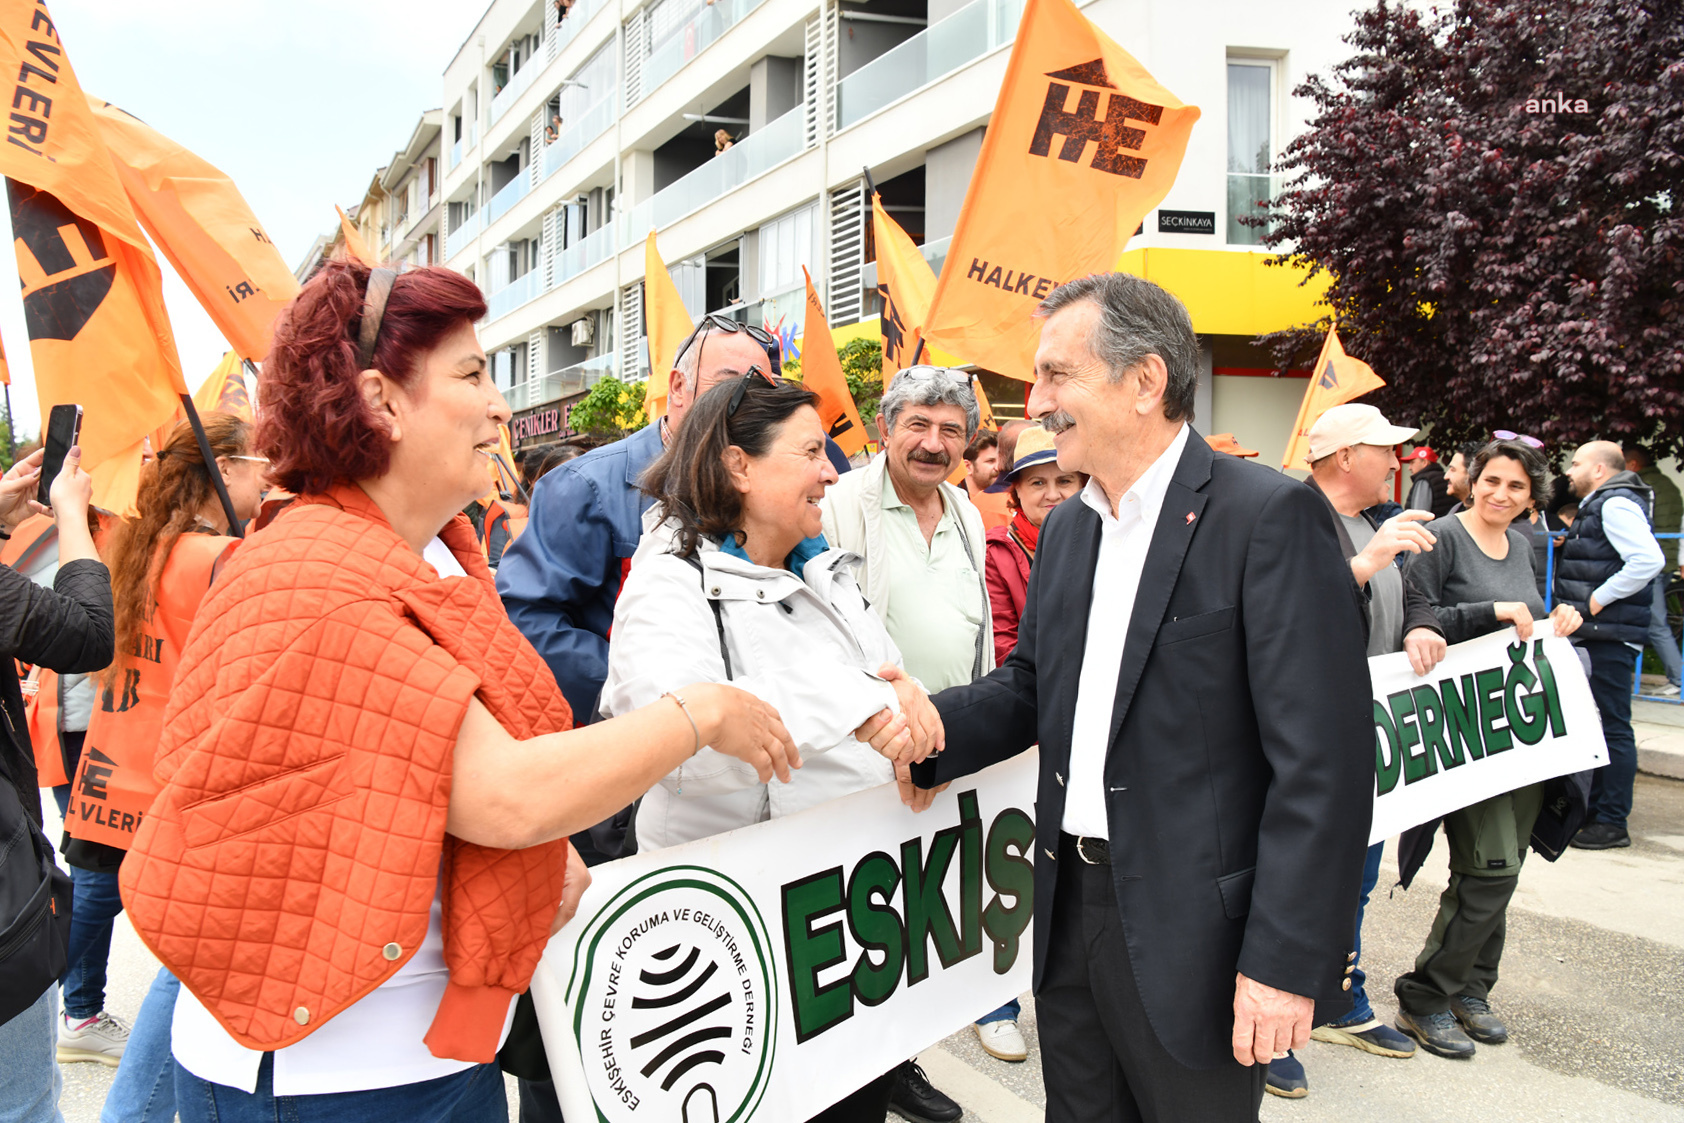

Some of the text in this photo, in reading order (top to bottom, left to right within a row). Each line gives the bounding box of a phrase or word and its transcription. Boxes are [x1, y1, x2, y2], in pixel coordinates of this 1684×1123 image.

[7, 0, 61, 163] EVLERİ
[1161, 216, 1212, 228] SEÇKİNKAYA
[564, 402, 577, 428] E
[781, 639, 1568, 1045] ESKİŞ DERNEĞİ
[598, 908, 755, 1111] ESKİŞEHİR ÇEVRE KORUMA VE GELİŞTİRME DERNEĞİ
